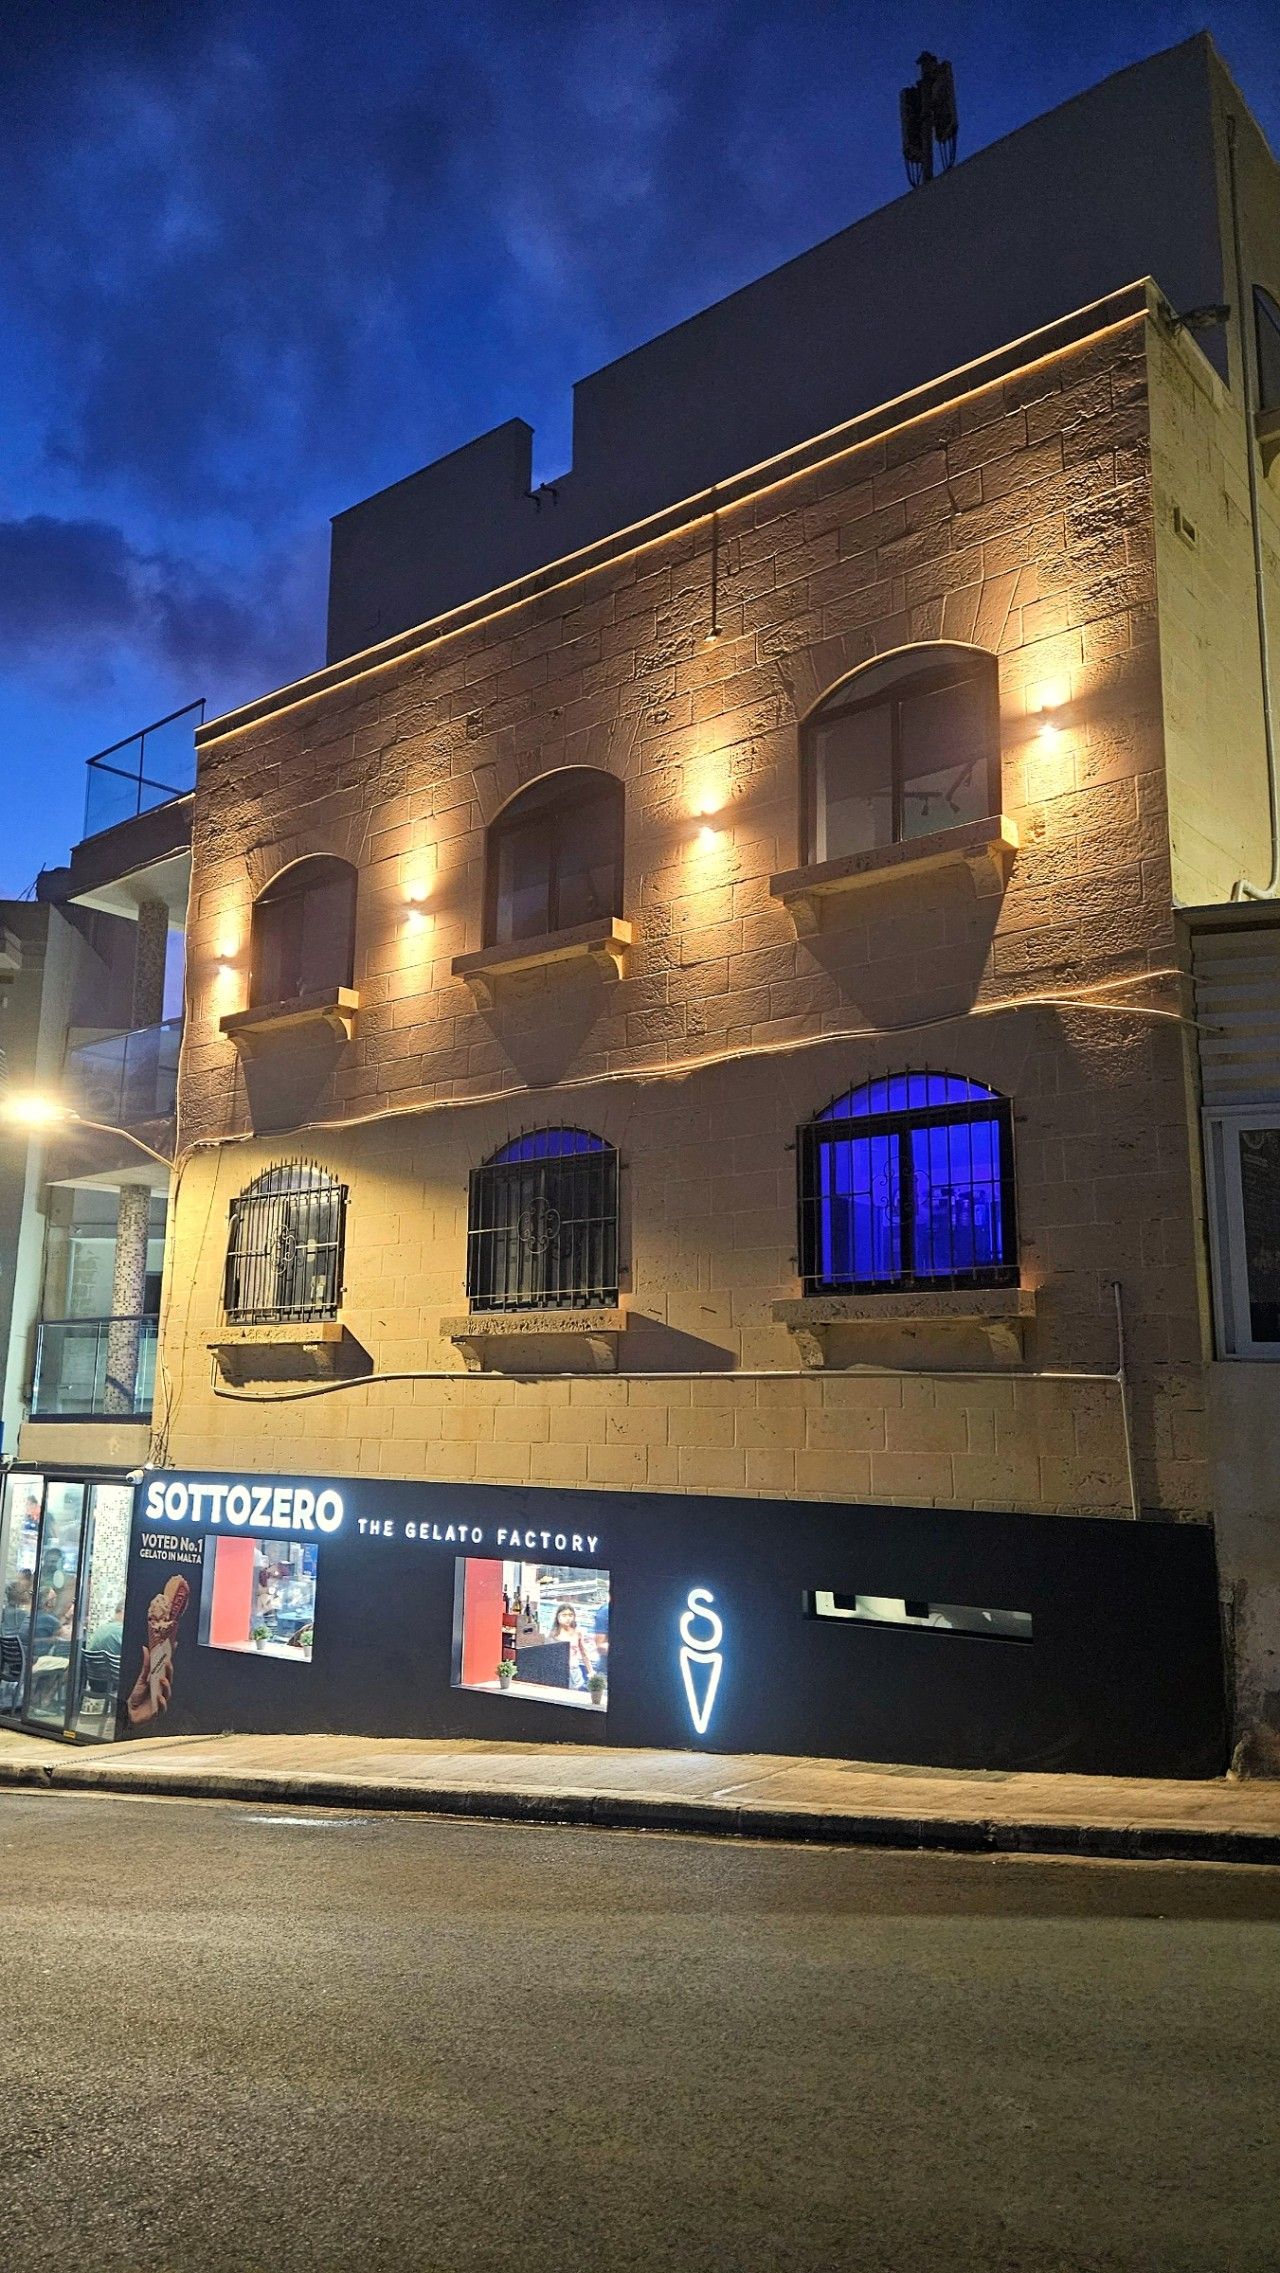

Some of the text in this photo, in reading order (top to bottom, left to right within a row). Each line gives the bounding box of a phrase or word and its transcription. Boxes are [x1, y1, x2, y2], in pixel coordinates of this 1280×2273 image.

[146, 1482, 344, 1532] SOTTOZERO
[141, 1533, 203, 1553] VOTED No.1
[357, 1518, 598, 1552] THE GELATO FACTORY
[139, 1548, 202, 1564] GELATO IN MALTA
